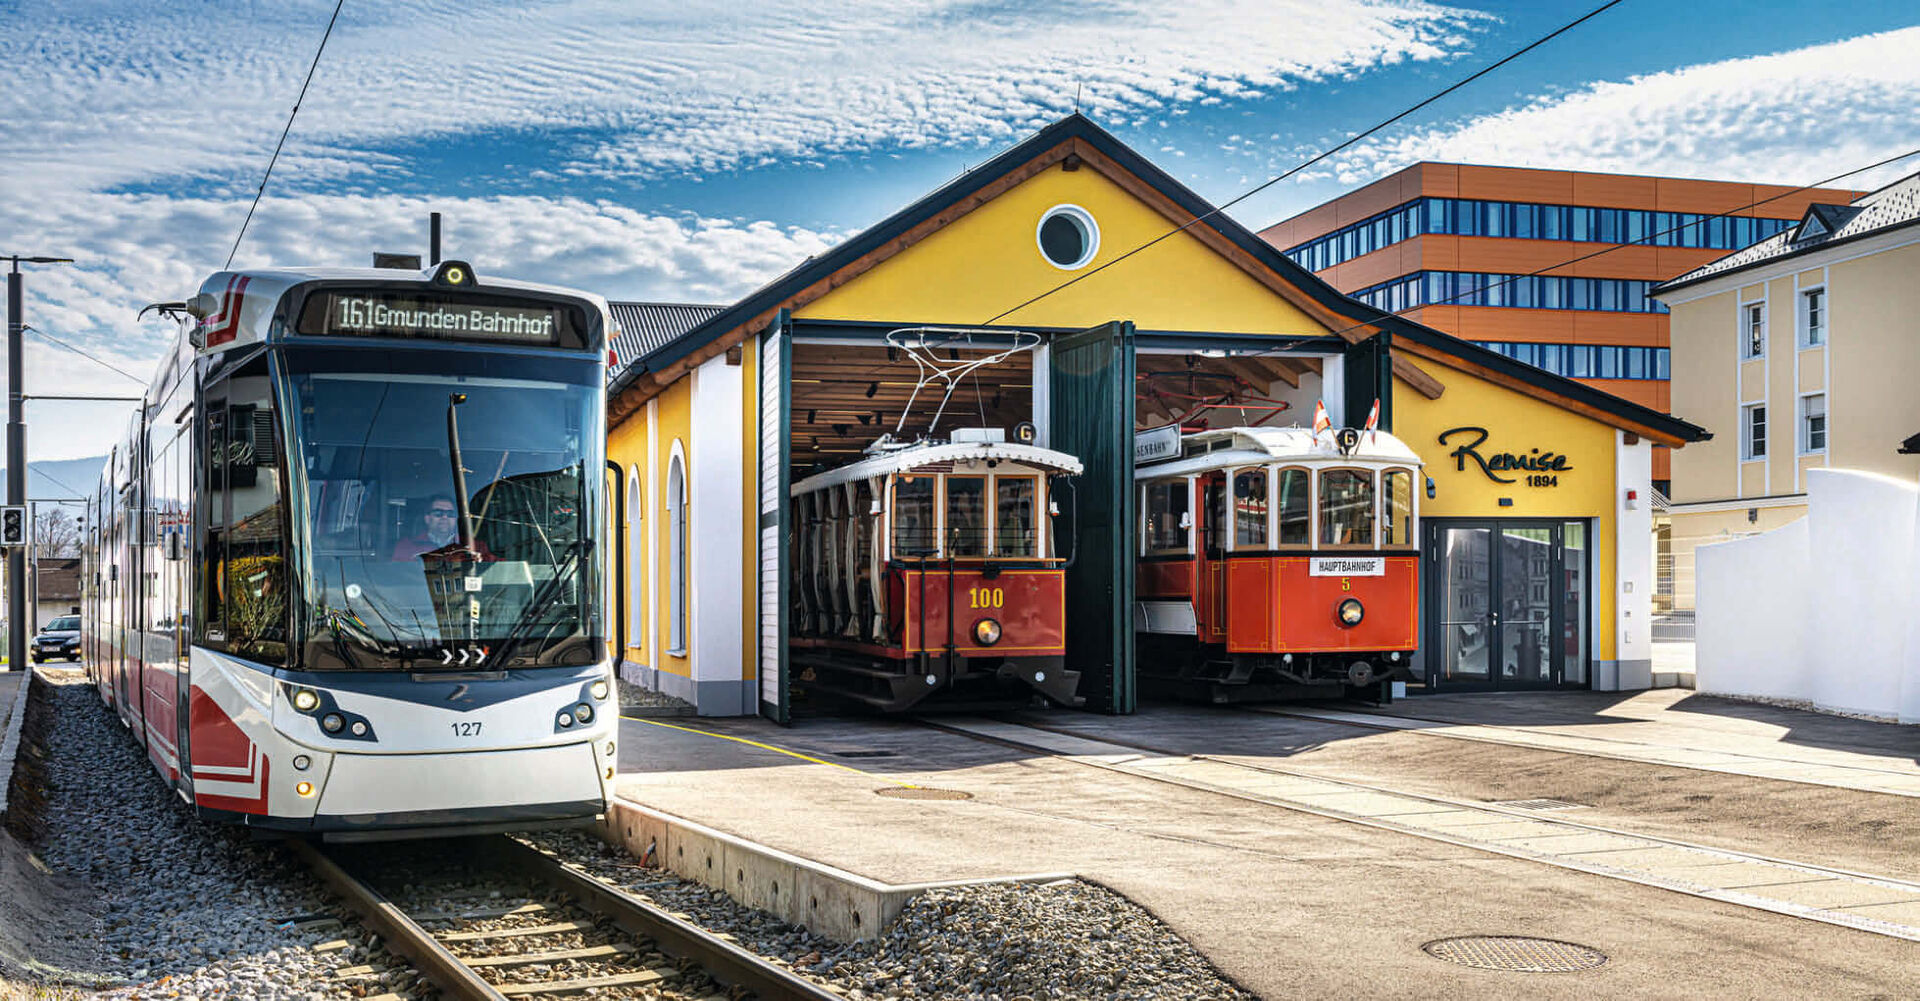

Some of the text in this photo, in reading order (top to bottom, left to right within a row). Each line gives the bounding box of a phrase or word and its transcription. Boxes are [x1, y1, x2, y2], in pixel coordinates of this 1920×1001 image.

[339, 298, 553, 336] 161 Gmunden Bahnhof
[1020, 425, 1032, 440] G
[1438, 426, 1573, 483] Remise
[1526, 475, 1558, 488] 1894
[1318, 561, 1376, 572] HAUPTBAHNHOF
[1341, 576, 1351, 592] 5
[969, 587, 1004, 609] 100
[451, 722, 482, 736] 127
